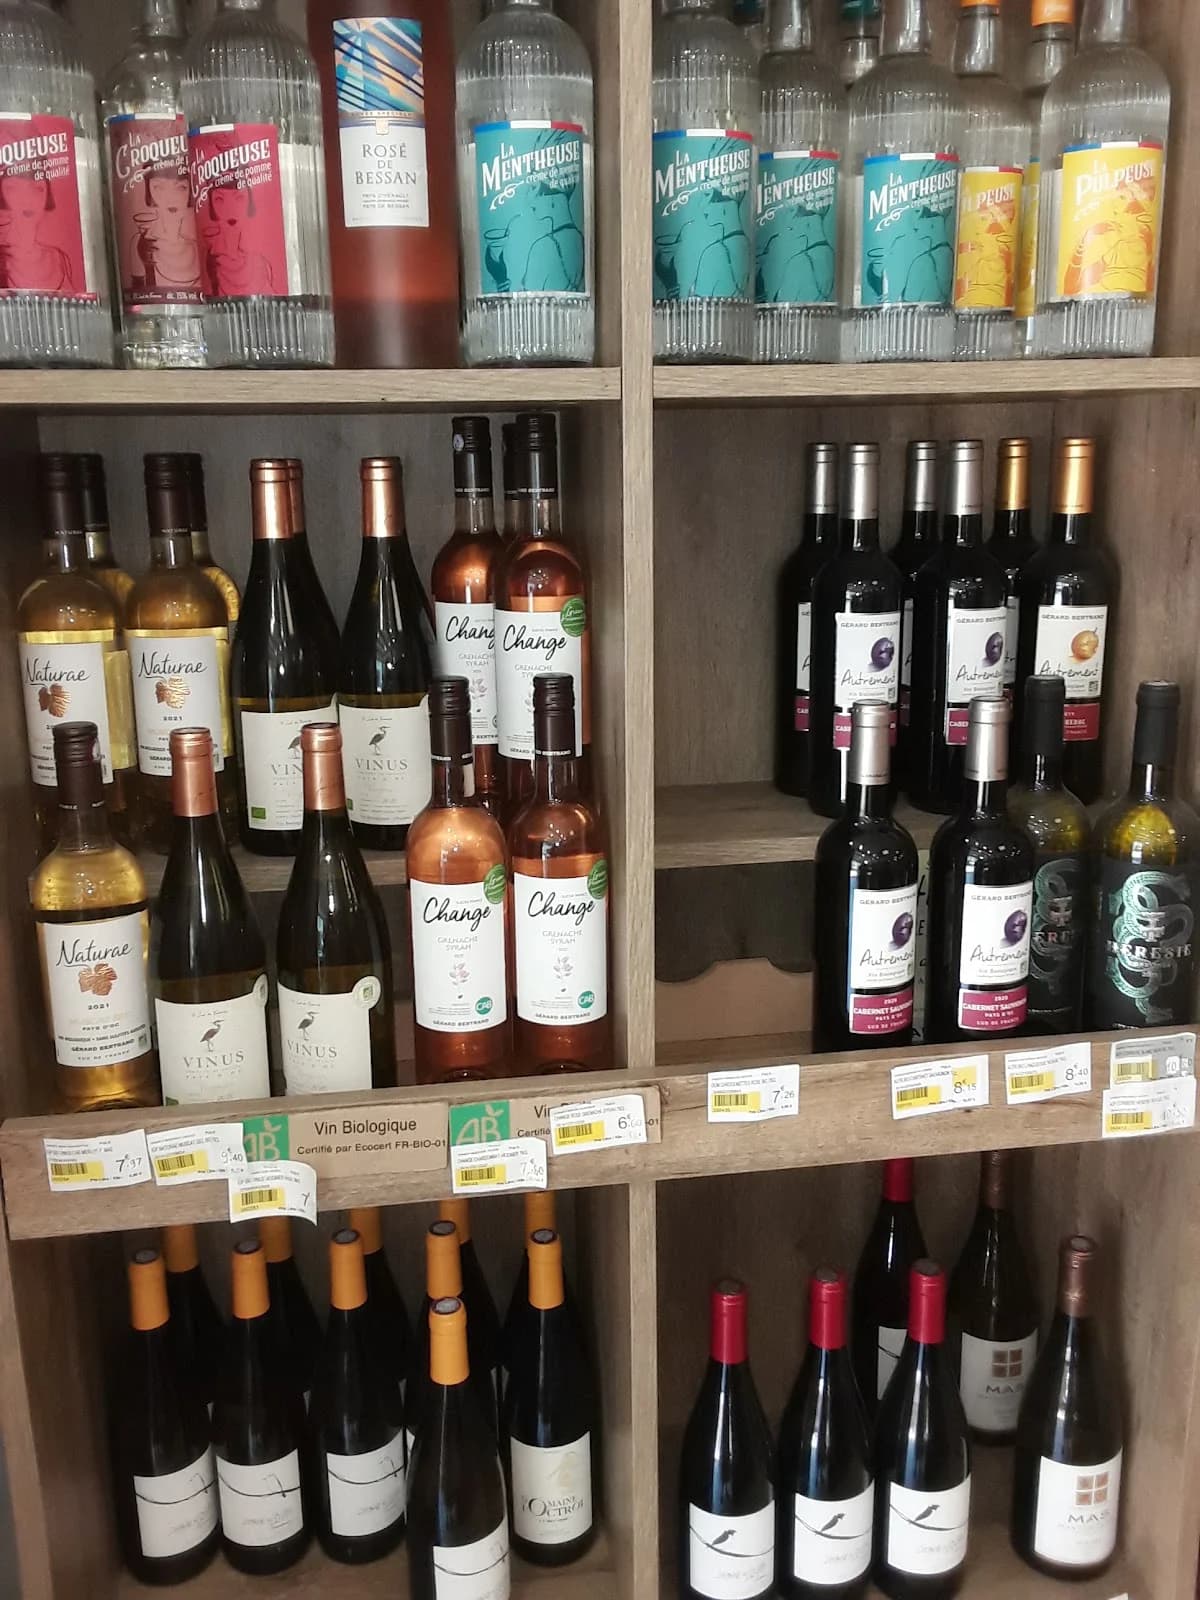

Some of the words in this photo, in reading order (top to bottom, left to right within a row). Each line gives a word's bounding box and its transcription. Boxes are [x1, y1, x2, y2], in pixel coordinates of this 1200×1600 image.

[362, 142, 407, 158] ROSÉ
[501, 142, 515, 160] LA
[6, 163, 30, 176] crème
[32, 159, 43, 170] de
[43, 156, 69, 171] pomme
[175, 156, 185, 166] de
[377, 160, 393, 169] DE
[676, 150, 690, 168] LA
[34, 170, 44, 181] de
[45, 166, 70, 181] qualité
[178, 166, 186, 176] de
[190, 139, 271, 198] CROQUEUSE
[215, 174, 234, 188] crème
[235, 168, 244, 179] de
[245, 162, 272, 179] pomme
[482, 140, 580, 197] MENTHEUSE
[549, 166, 558, 178] de
[655, 148, 751, 204] MENTHEUSE
[237, 179, 246, 189] de
[246, 173, 272, 189] qualité
[355, 170, 417, 185] BESSAN
[549, 179, 559, 189] de
[890, 172, 903, 187] LA
[869, 169, 957, 221] MENTHEUSE
[502, 624, 568, 661] Change
[24, 656, 89, 686] Naturae
[138, 650, 208, 679] Naturae
[354, 758, 409, 772] VINUS
[423, 896, 491, 932] Change
[528, 890, 595, 926] Change
[56, 938, 131, 967] Naturae
[88, 1002, 110, 1010] 2021
[853, 1007, 889, 1015] CABERNET
[963, 1003, 1000, 1011] CABERNET
[457, 1018, 489, 1027] BERTRAND
[560, 1012, 590, 1020] BERTRAND
[99, 1038, 135, 1050] BERTRAND
[287, 1039, 337, 1058] VINUS
[183, 1050, 245, 1068] VINUS
[314, 1121, 337, 1136] Vin
[343, 1118, 417, 1136] Biologique
[297, 1142, 333, 1155] Certifié
[336, 1145, 351, 1155] par
[355, 1142, 392, 1152] Ecocert
[395, 1138, 446, 1150] FR-BIO-01
